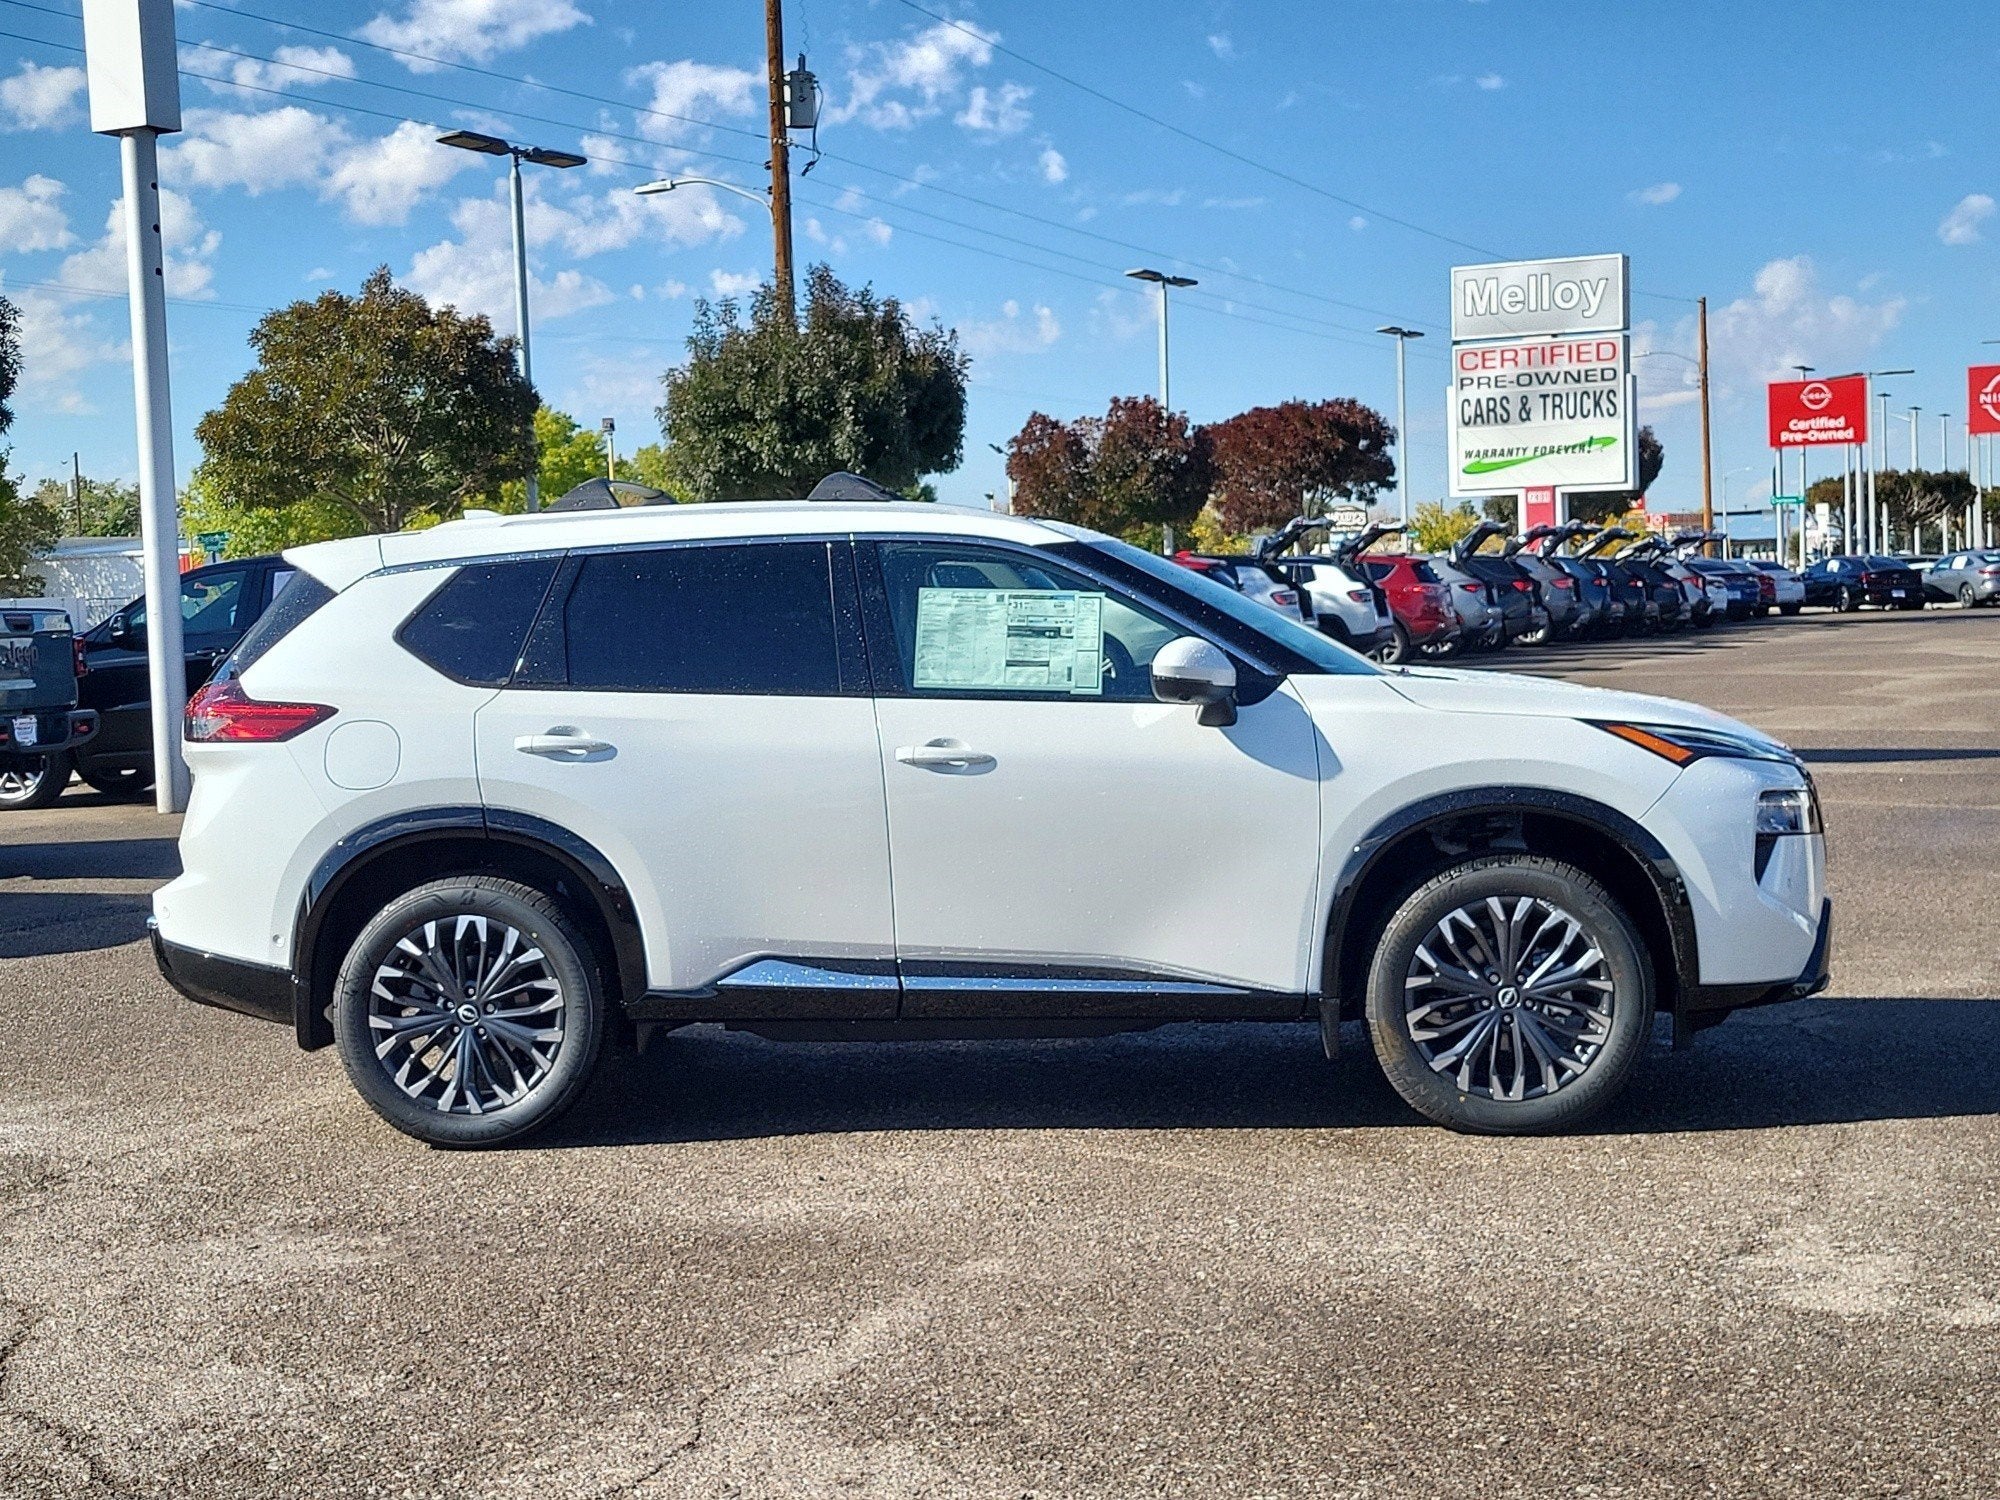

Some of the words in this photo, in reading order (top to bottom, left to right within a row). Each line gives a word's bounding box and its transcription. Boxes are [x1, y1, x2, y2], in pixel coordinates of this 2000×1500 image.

[1463, 273, 1609, 318] Melloy
[1459, 341, 1617, 371] CERTIFIED
[1460, 368, 1617, 390] PRE-OWNED
[1461, 396, 1511, 426] CARS
[1518, 395, 1532, 422] &
[1539, 389, 1618, 421] TRUCKS
[1780, 426, 1855, 443] Pre-Owned
[1788, 415, 1846, 431] Certified
[1464, 446, 1529, 460] WARRANTY
[1533, 435, 1594, 456] FOREVER!
[6, 640, 39, 669] Jeep
